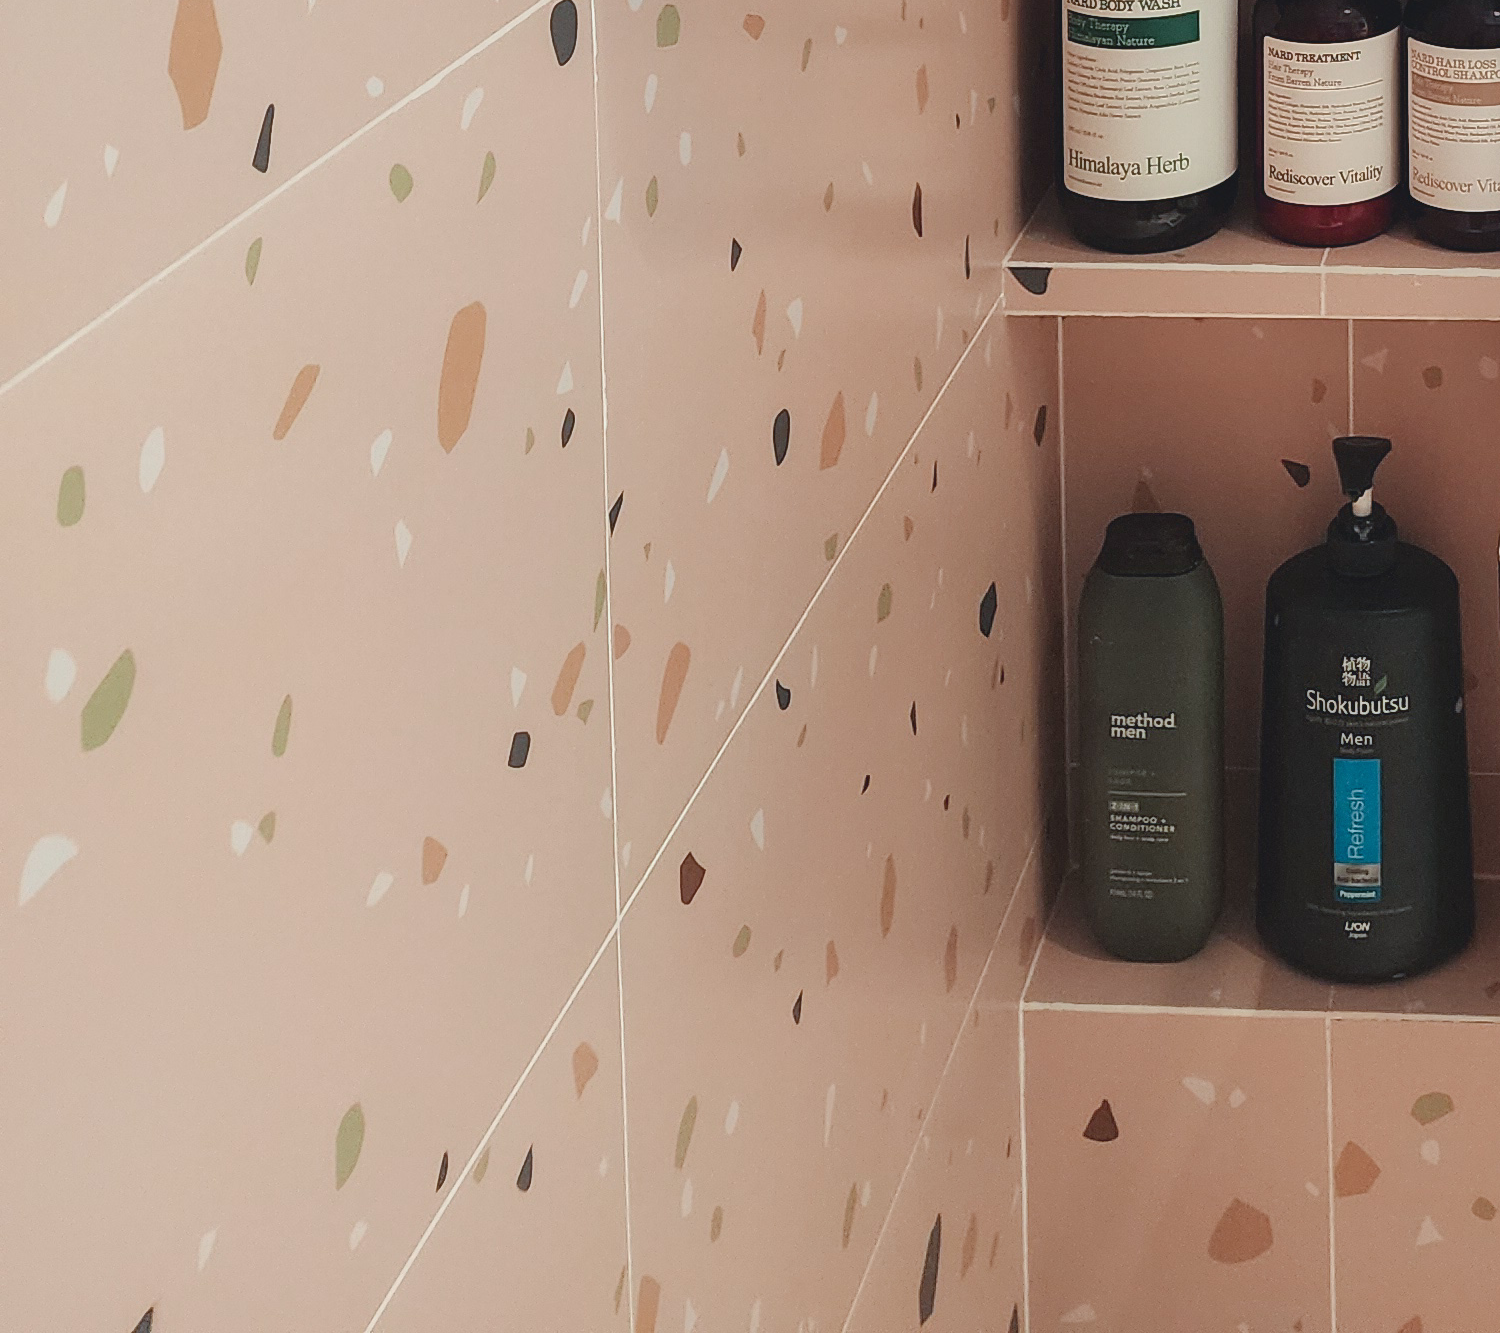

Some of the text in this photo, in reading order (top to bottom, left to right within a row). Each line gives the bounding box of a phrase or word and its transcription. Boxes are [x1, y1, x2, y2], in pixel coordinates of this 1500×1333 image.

[1099, 0, 1135, 11] BODY
[1088, 18, 1130, 34] Therapy
[1116, 35, 1155, 46] Nature
[1268, 47, 1361, 63] NARD TREATMENT
[1436, 57, 1466, 69] HAIR
[1468, 59, 1497, 70] LOSS
[1283, 64, 1314, 78] Therapy
[1068, 148, 1190, 180] Himalaya Herb
[1269, 164, 1383, 186] Rediscover Vitality
[1412, 166, 1473, 193] Rediscover
[1306, 689, 1409, 715] Shokubutsu
[1111, 712, 1175, 728] method
[1111, 726, 1147, 739] men
[1340, 733, 1373, 745] Men
[1110, 814, 1157, 823] SHAMPOO
[1347, 789, 1365, 859] Refresh
[1109, 823, 1175, 832] CONDITIONER
[1345, 921, 1371, 931] LION
